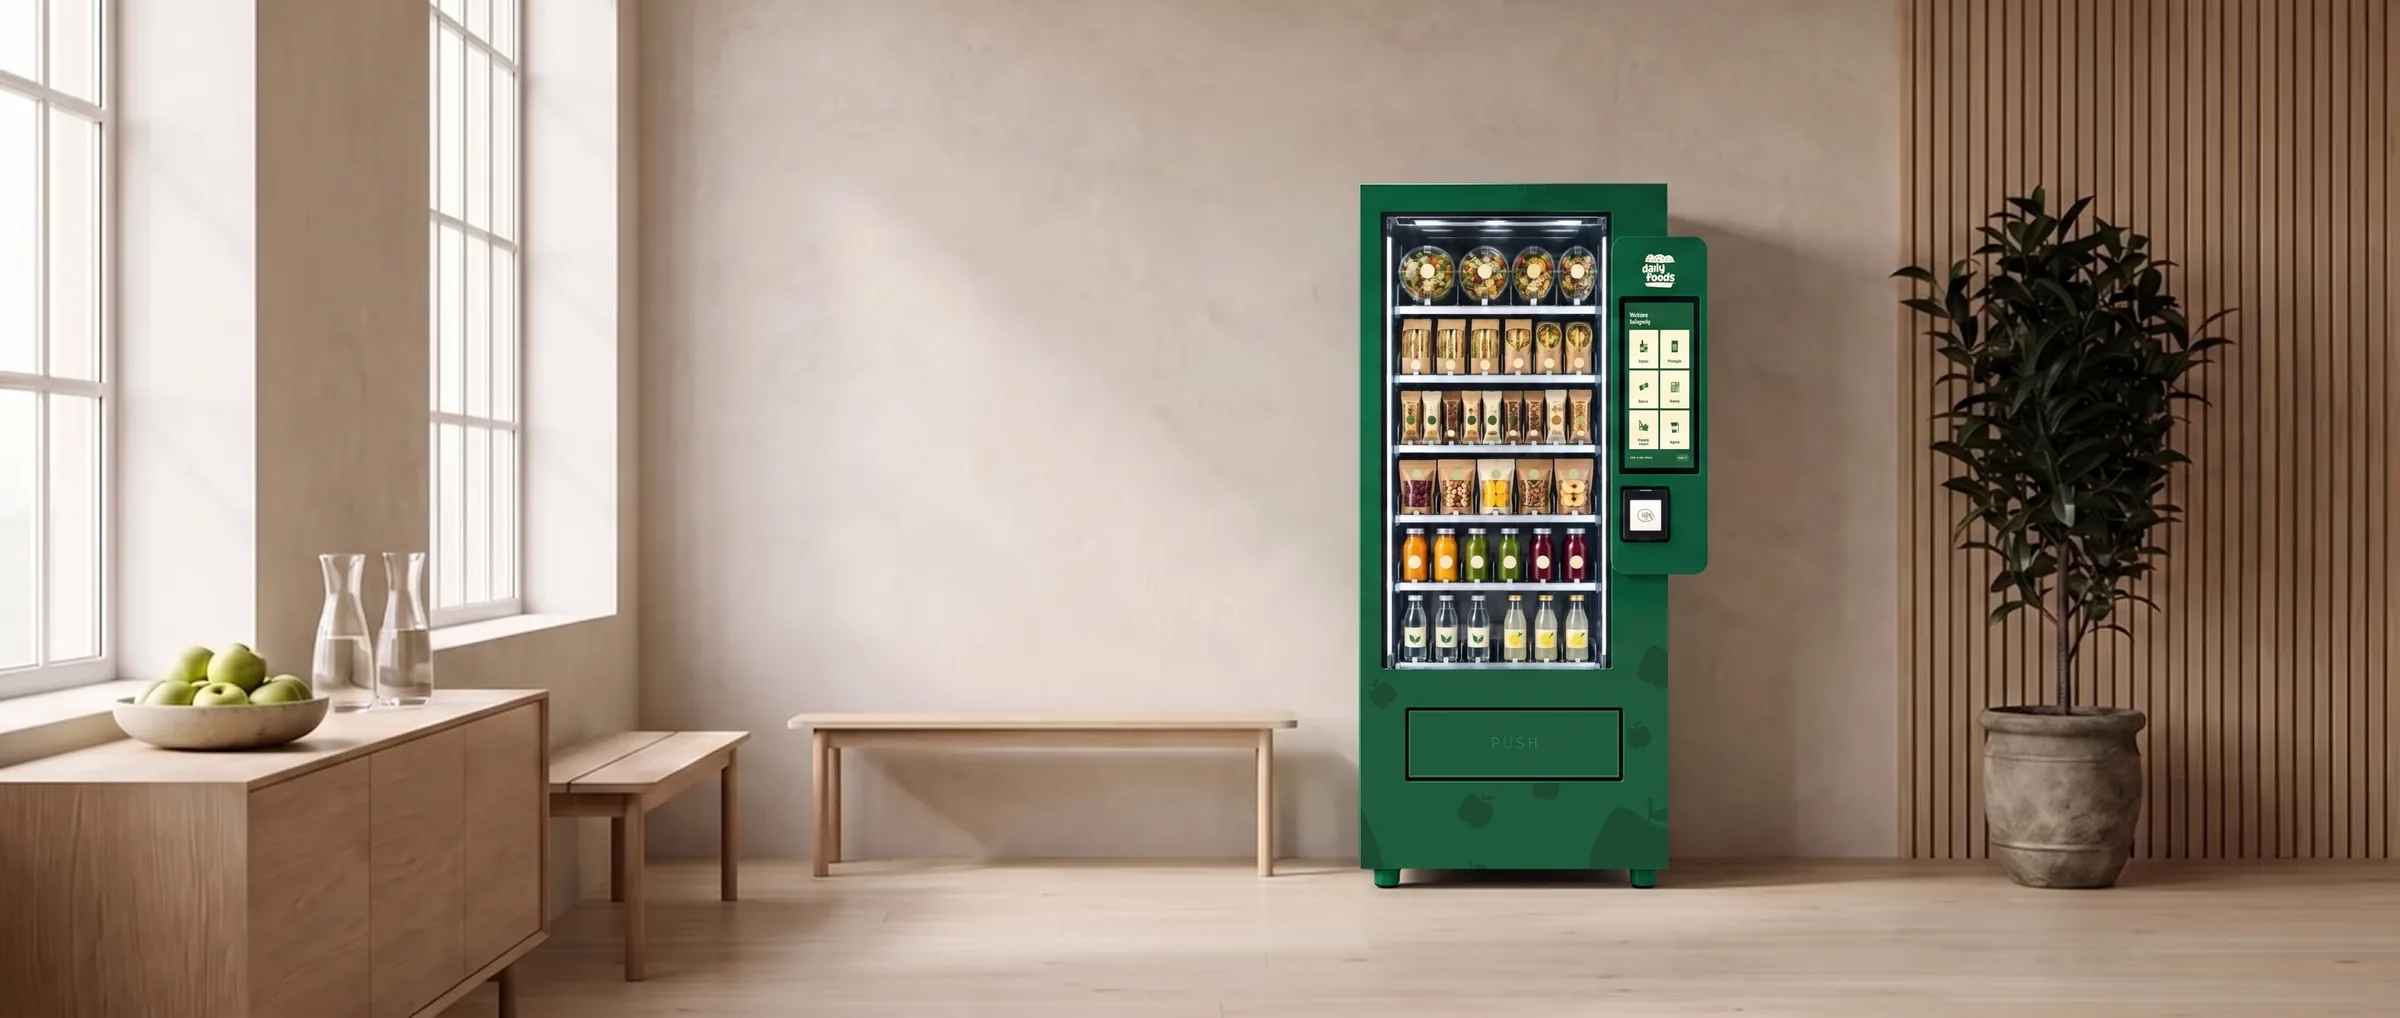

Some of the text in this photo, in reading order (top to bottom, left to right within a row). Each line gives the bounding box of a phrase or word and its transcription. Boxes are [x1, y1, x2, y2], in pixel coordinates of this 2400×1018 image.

[1642, 263, 1665, 274] daily
[1646, 272, 1675, 282] foods
[1491, 736, 1538, 750] PUSH
